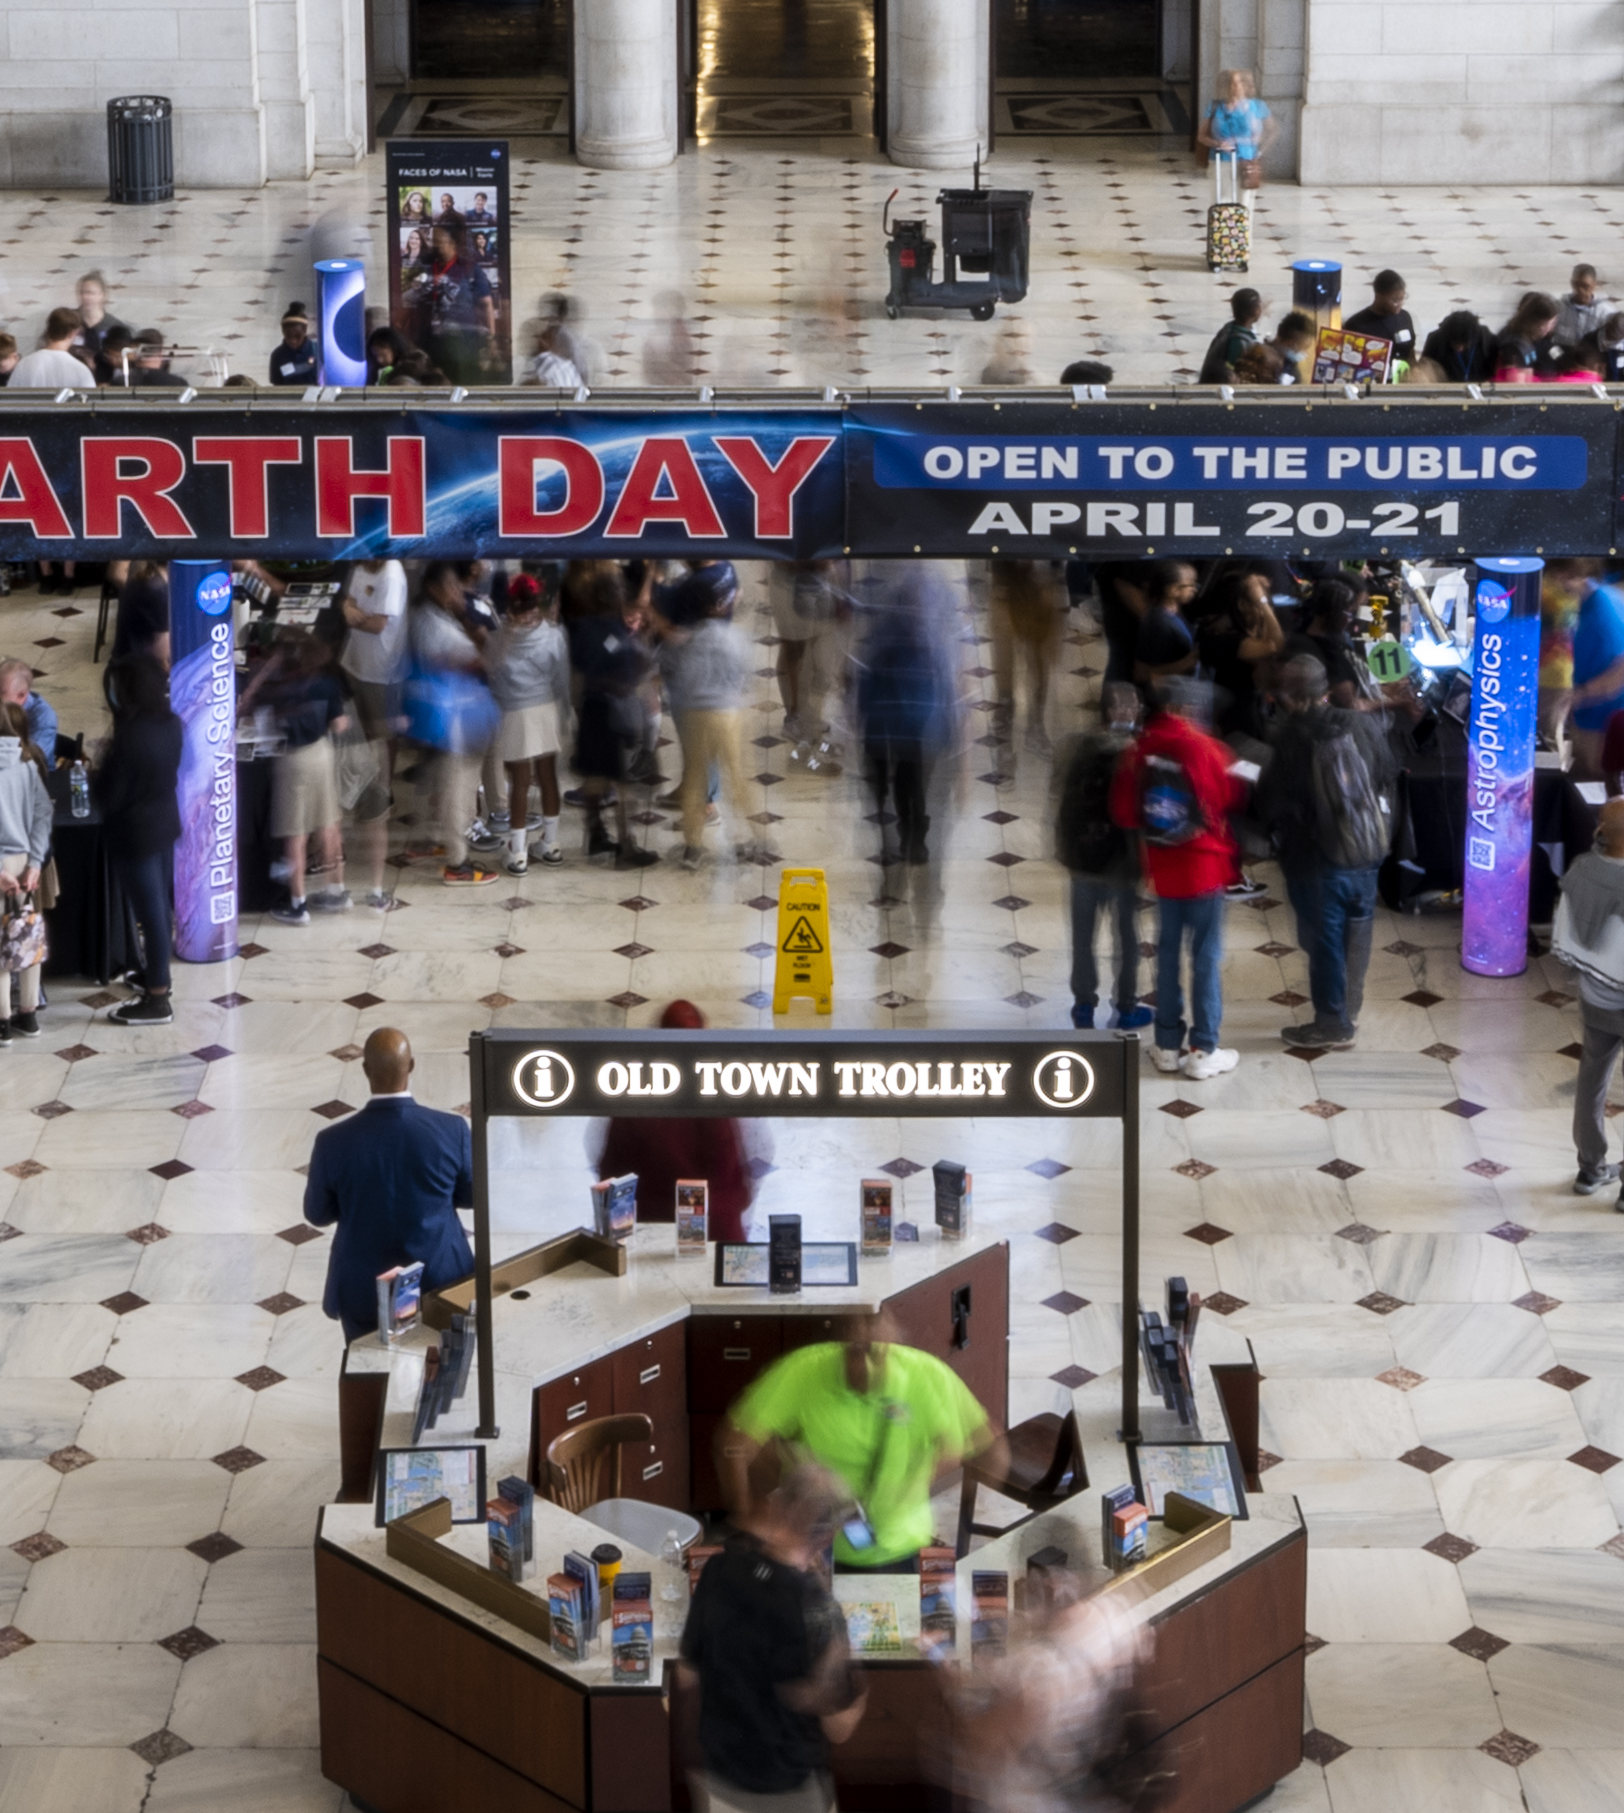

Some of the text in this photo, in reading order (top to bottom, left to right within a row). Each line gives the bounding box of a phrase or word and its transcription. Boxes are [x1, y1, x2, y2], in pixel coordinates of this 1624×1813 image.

[399, 168, 427, 176] FACES
[923, 445, 1539, 481] OPEN TO THE PUBLIC
[497, 434, 837, 539] DAY
[967, 500, 1464, 538] APRIL 20-21
[1371, 648, 1403, 676] 11
[1472, 632, 1506, 832] Astrophysics
[206, 622, 235, 888] Planetary Science
[786, 902, 821, 912] CAUTION
[597, 1061, 1012, 1098] OLD TOWN TROLLEY
